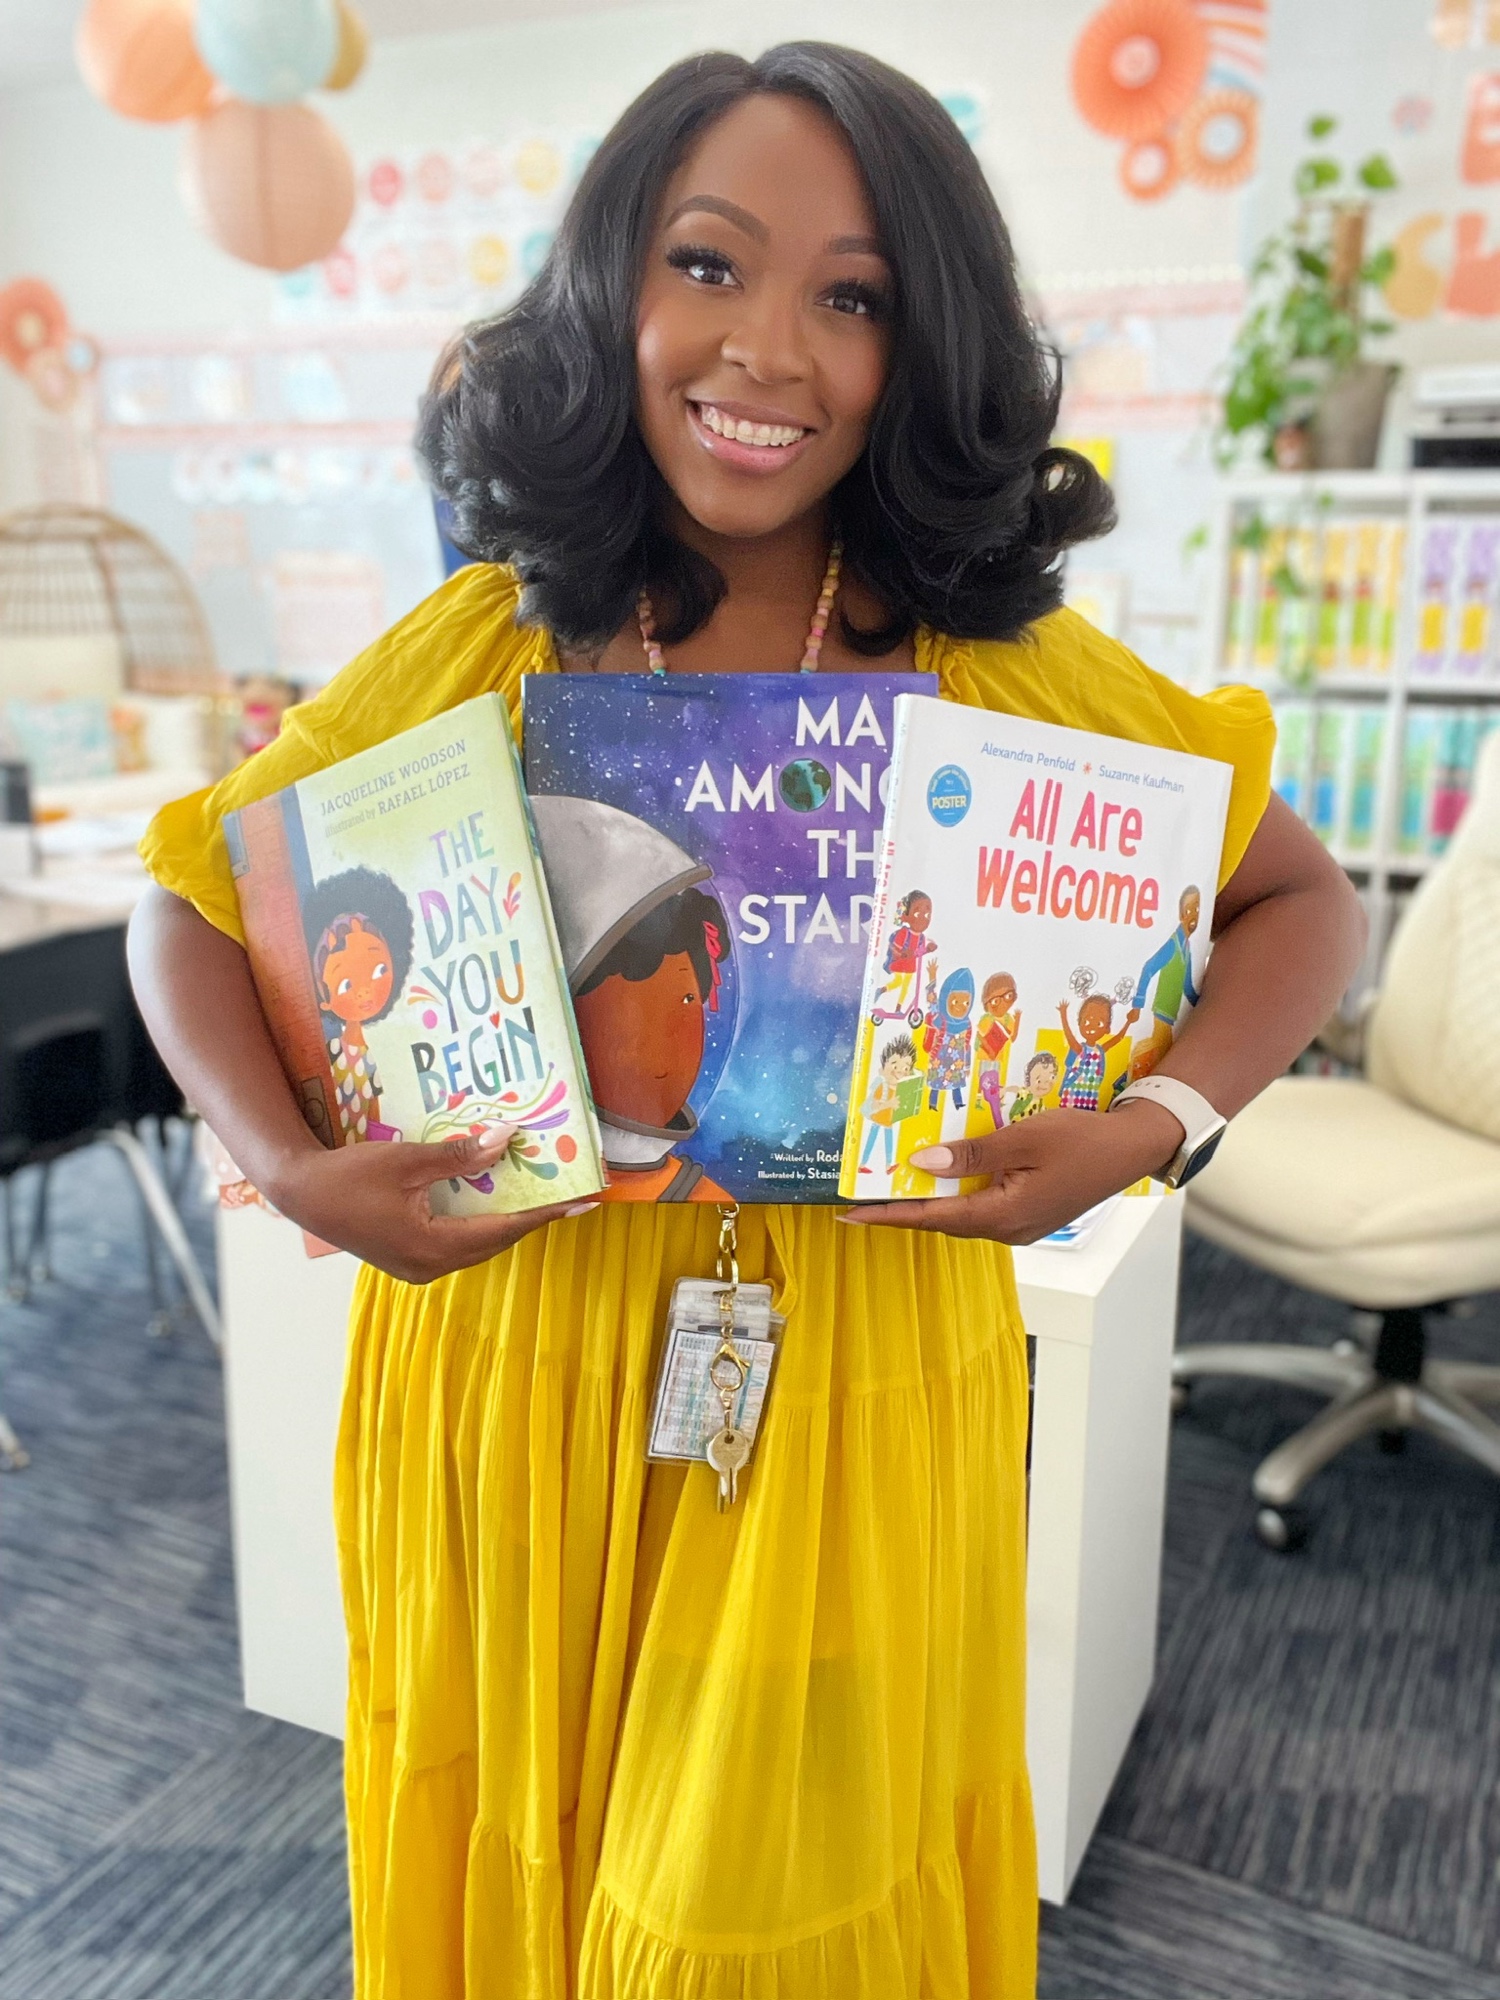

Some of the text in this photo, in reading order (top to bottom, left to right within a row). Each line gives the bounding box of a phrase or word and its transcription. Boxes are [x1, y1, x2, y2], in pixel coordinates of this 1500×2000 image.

[795, 693, 886, 747] MA
[320, 739, 467, 816] JACQUELINE WOODSON
[981, 742, 1185, 794] Alexandra Penfold Suzanne Kaufman
[325, 763, 471, 838] illustrated by RAFAEL LÓPEZ
[932, 795, 967, 809] POSTER
[1009, 778, 1143, 857] All Are
[429, 811, 495, 878] THE
[807, 828, 883, 880] TH
[418, 867, 504, 958] DAY
[975, 845, 1159, 929] Welcome
[739, 894, 874, 944] STAR
[420, 939, 524, 1034] YOU
[758, 1168, 841, 1180] Illustrated by Stasia
[774, 1152, 804, 1162] Written
[805, 1153, 814, 1163] by
